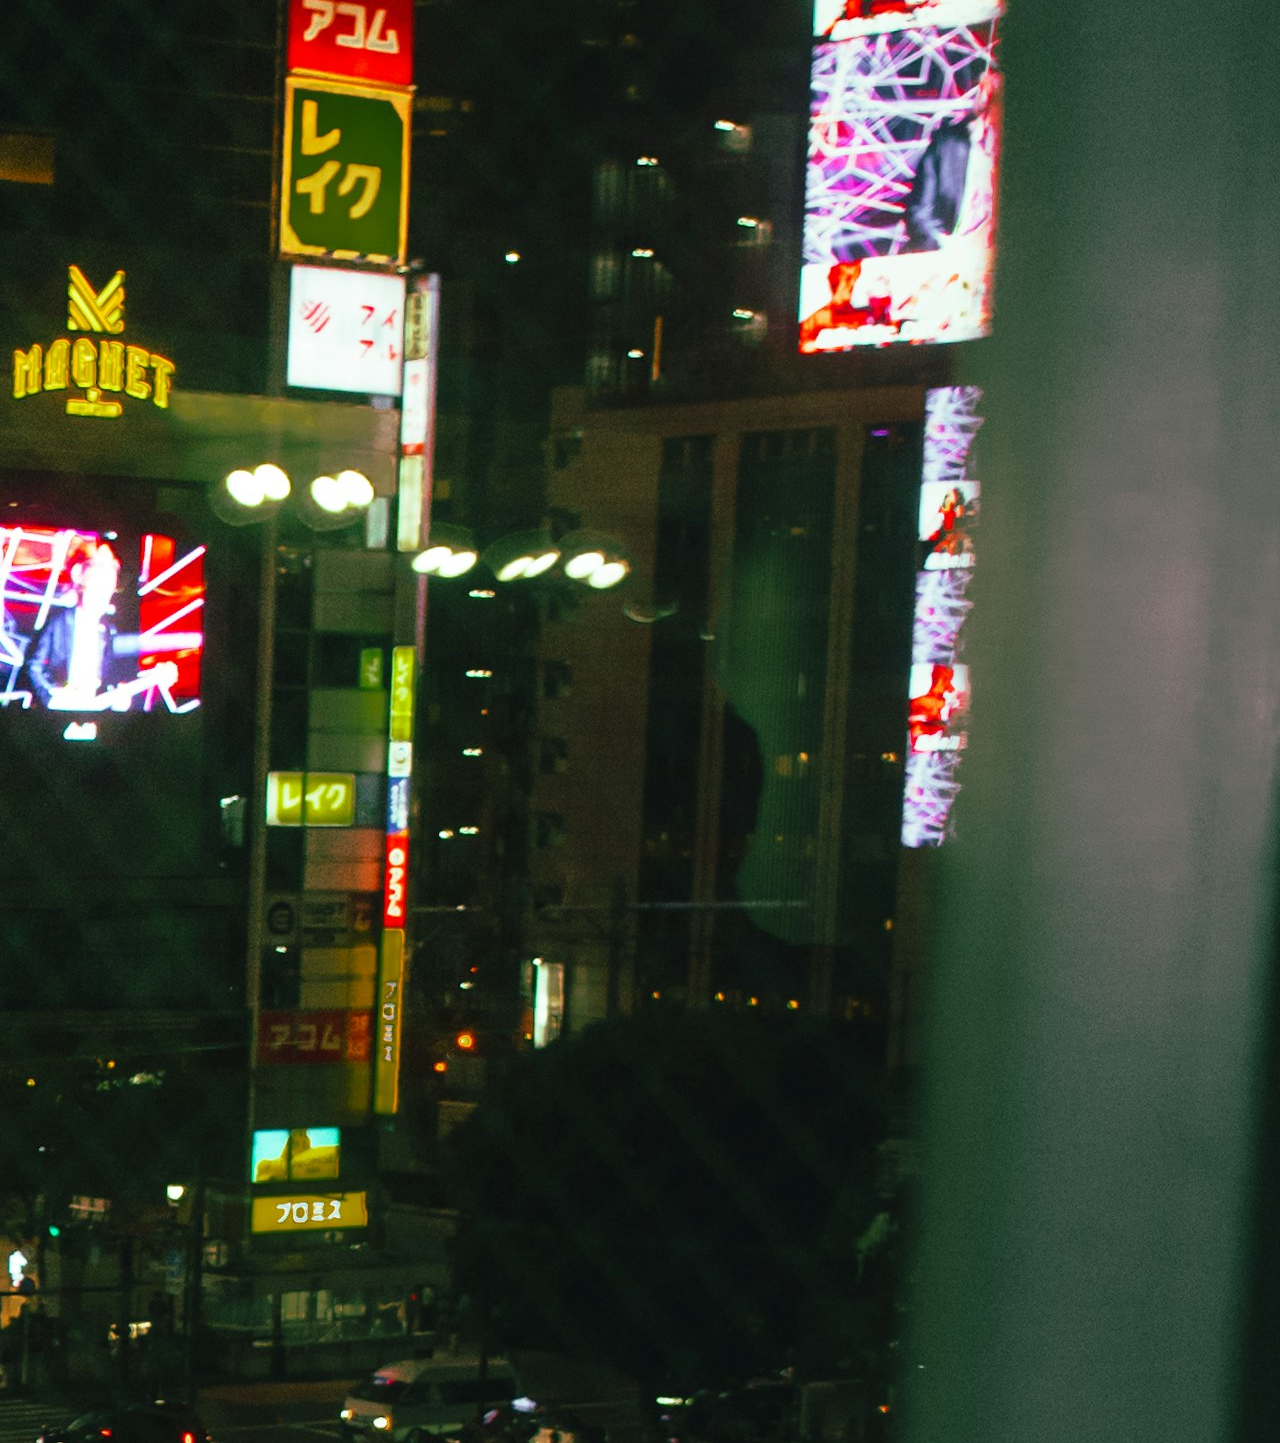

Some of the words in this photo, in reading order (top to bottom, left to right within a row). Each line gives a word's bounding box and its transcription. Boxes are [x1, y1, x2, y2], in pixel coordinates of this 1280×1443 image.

[13, 338, 176, 409] MAGNET
[280, 782, 347, 812] レイク
